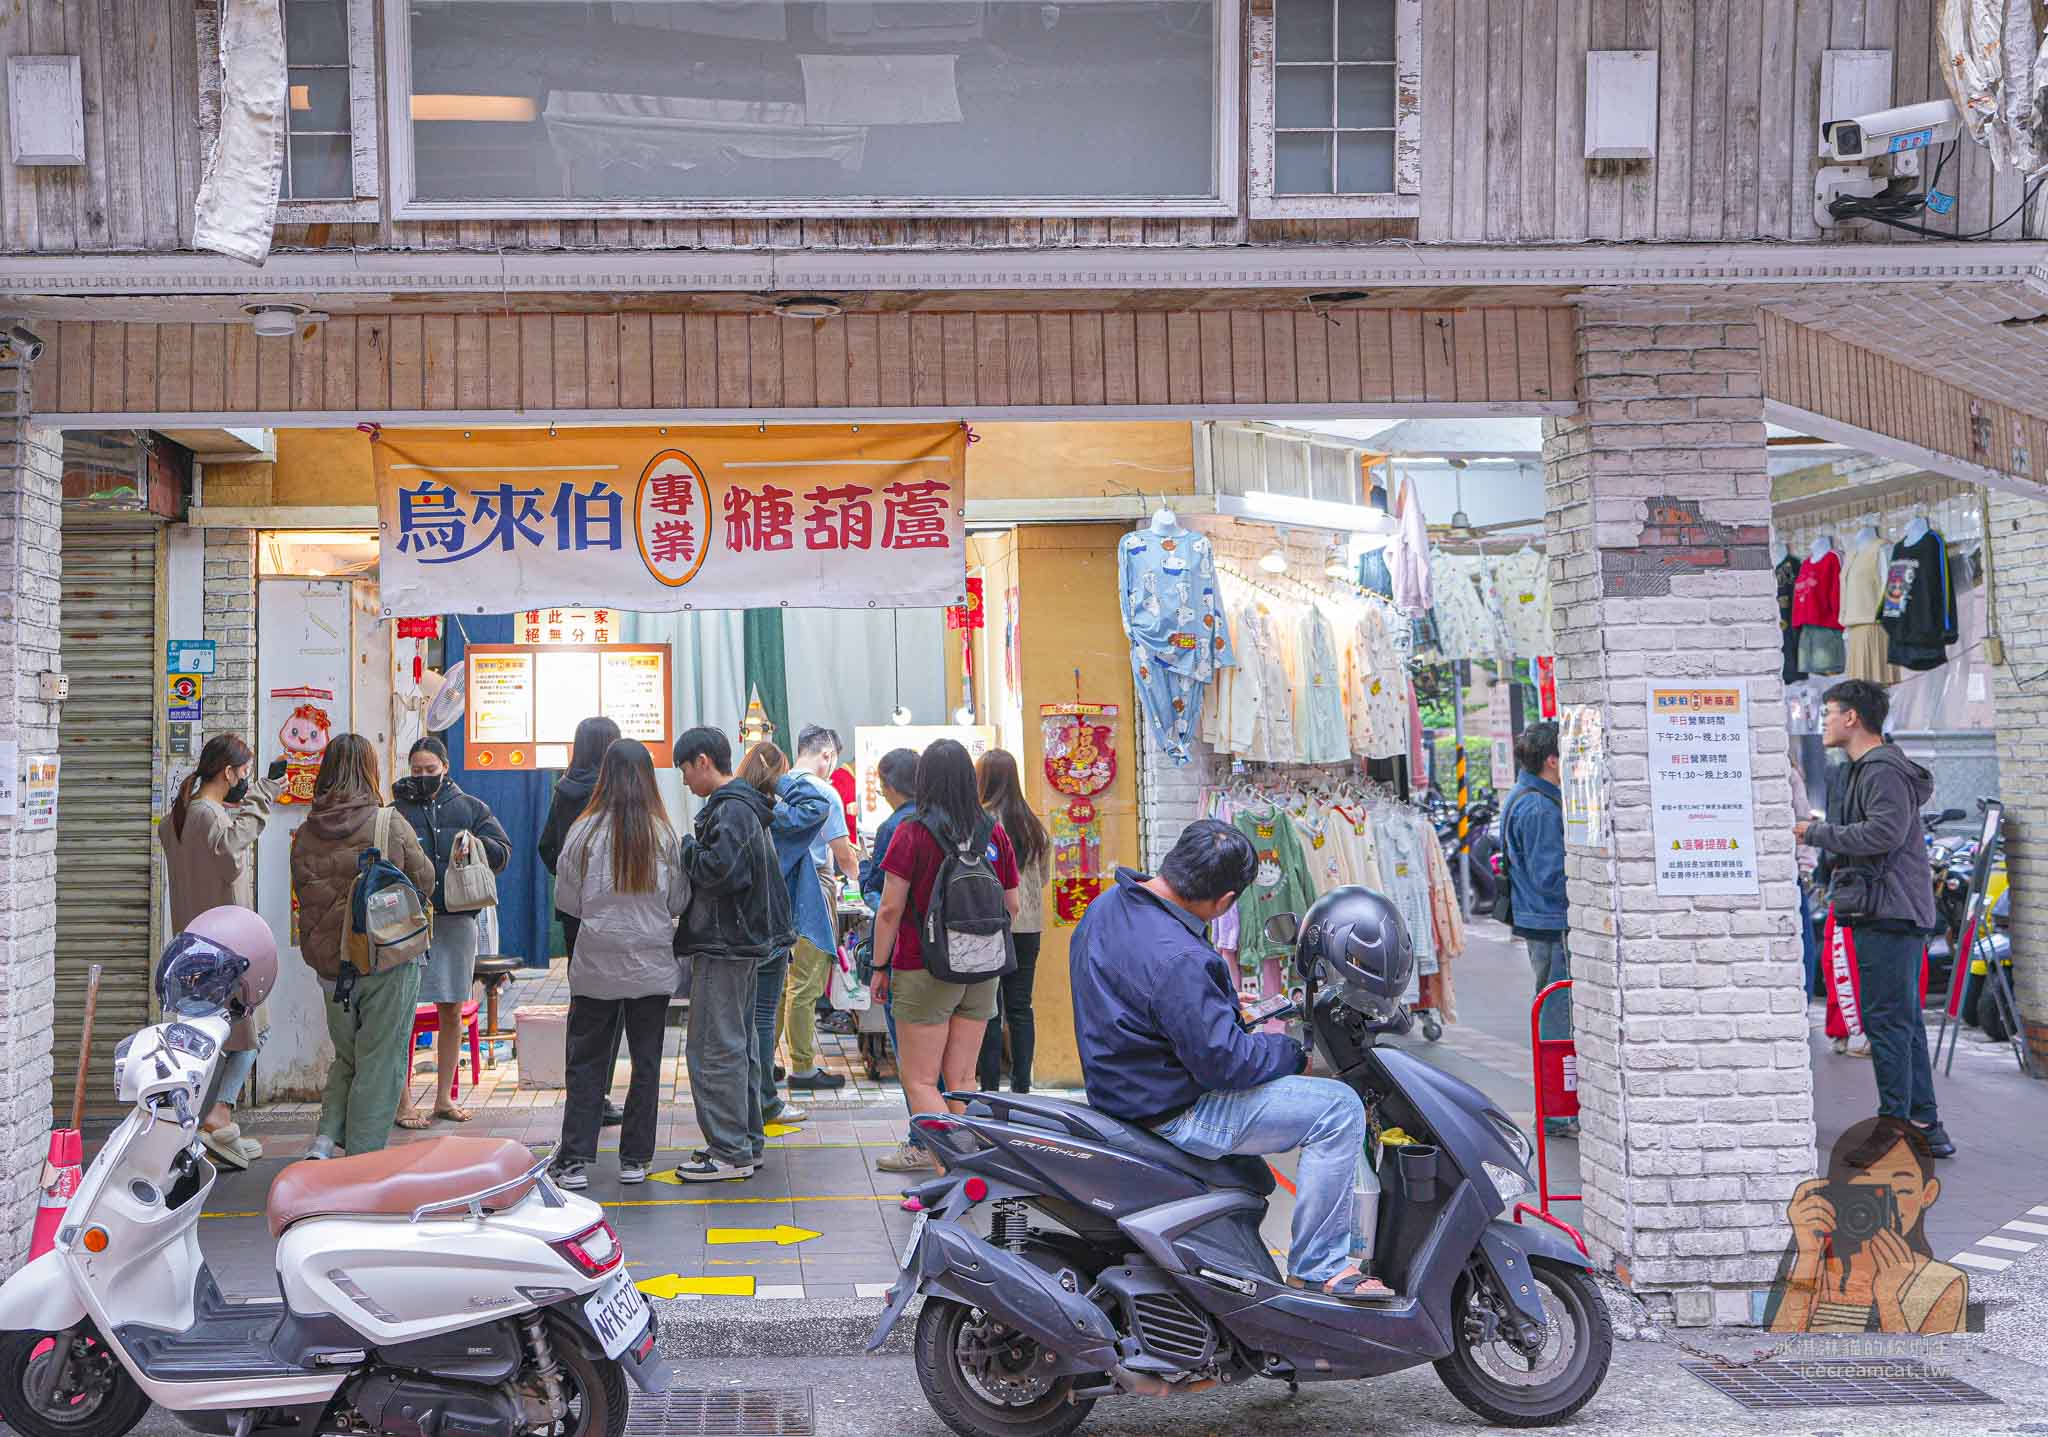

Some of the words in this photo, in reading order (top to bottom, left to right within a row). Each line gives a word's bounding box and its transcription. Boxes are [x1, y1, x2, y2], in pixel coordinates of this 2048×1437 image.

[650, 472, 694, 563] 專業
[723, 479, 950, 552] 糖葫蘆
[525, 609, 609, 625] 僅此一家
[525, 627, 609, 643] 絕無分店
[191, 657, 200, 670] 9
